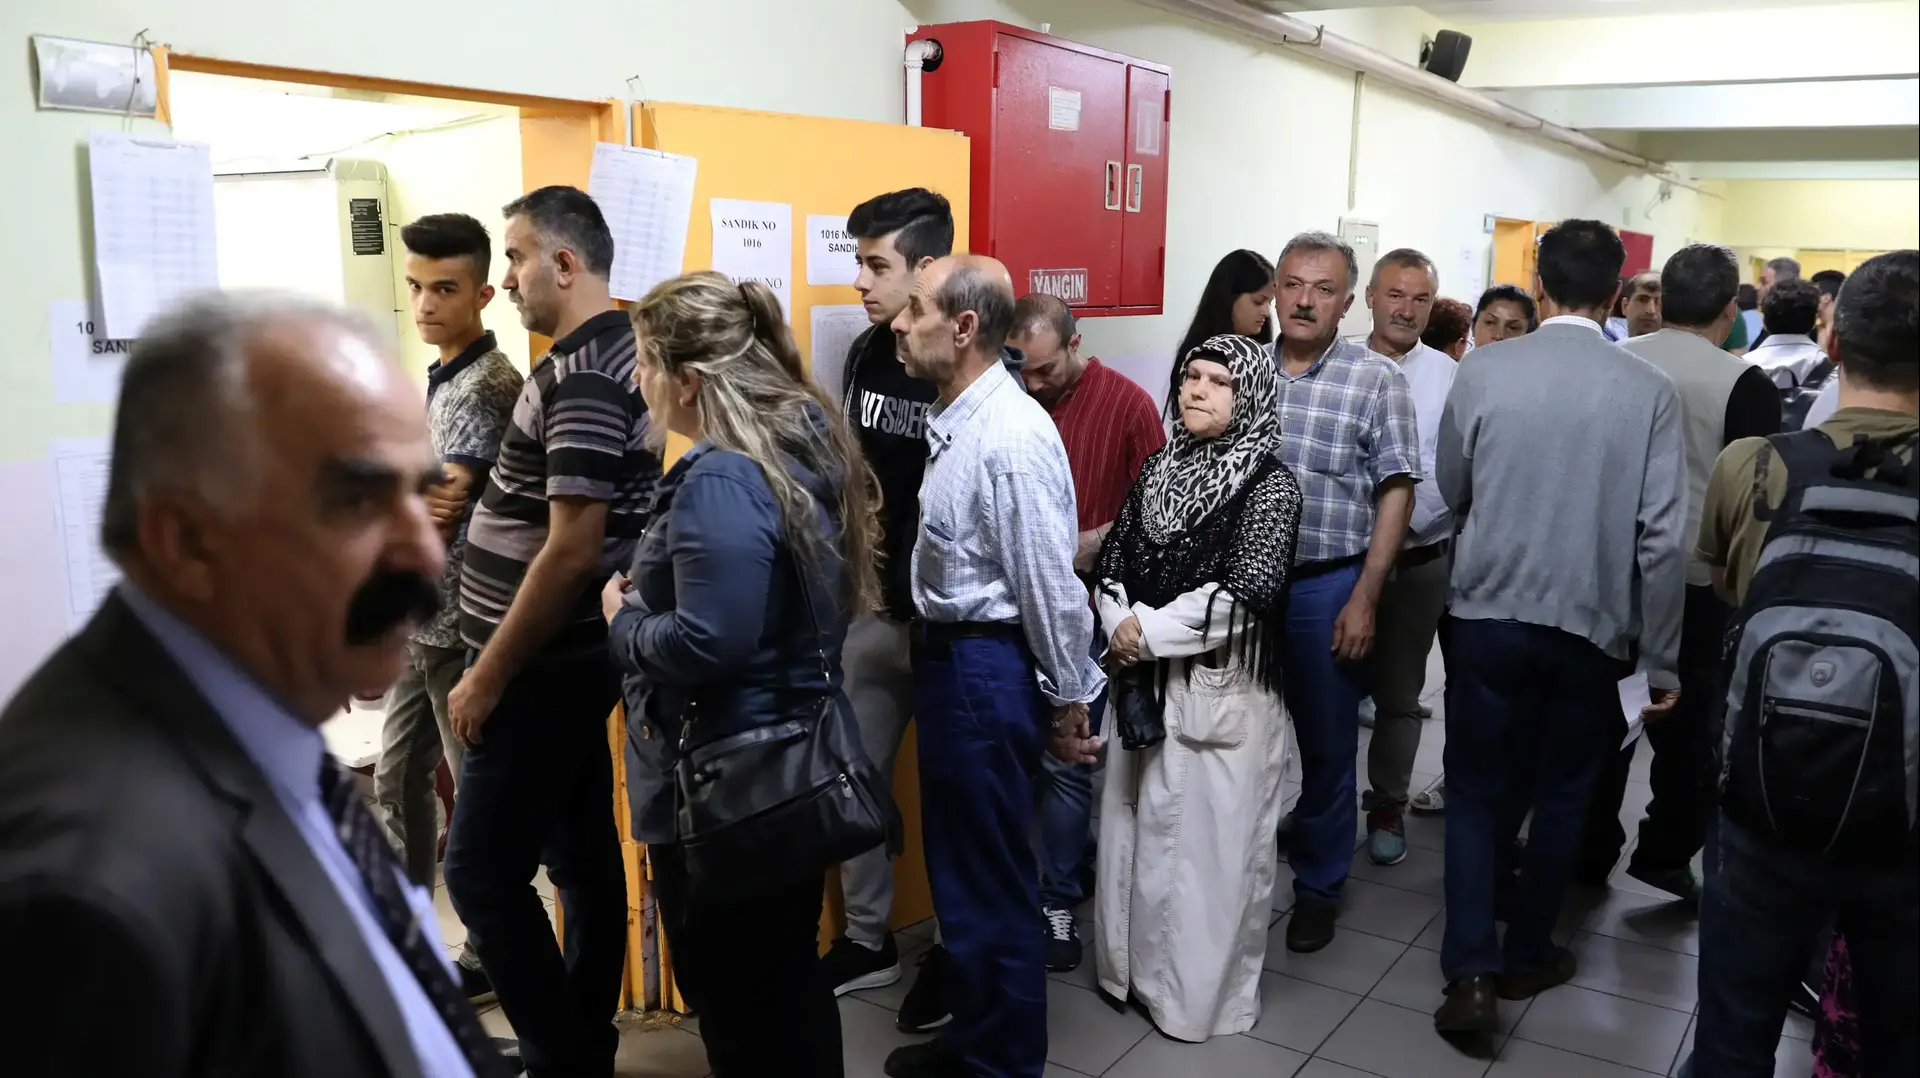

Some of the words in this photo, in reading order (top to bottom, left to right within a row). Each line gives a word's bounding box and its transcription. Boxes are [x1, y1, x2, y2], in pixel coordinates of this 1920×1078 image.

[721, 218, 760, 230] SANDIK
[761, 220, 777, 231] NO
[820, 229, 840, 240] 1016
[742, 237, 762, 248] 1016
[1034, 274, 1084, 300] YANGIN
